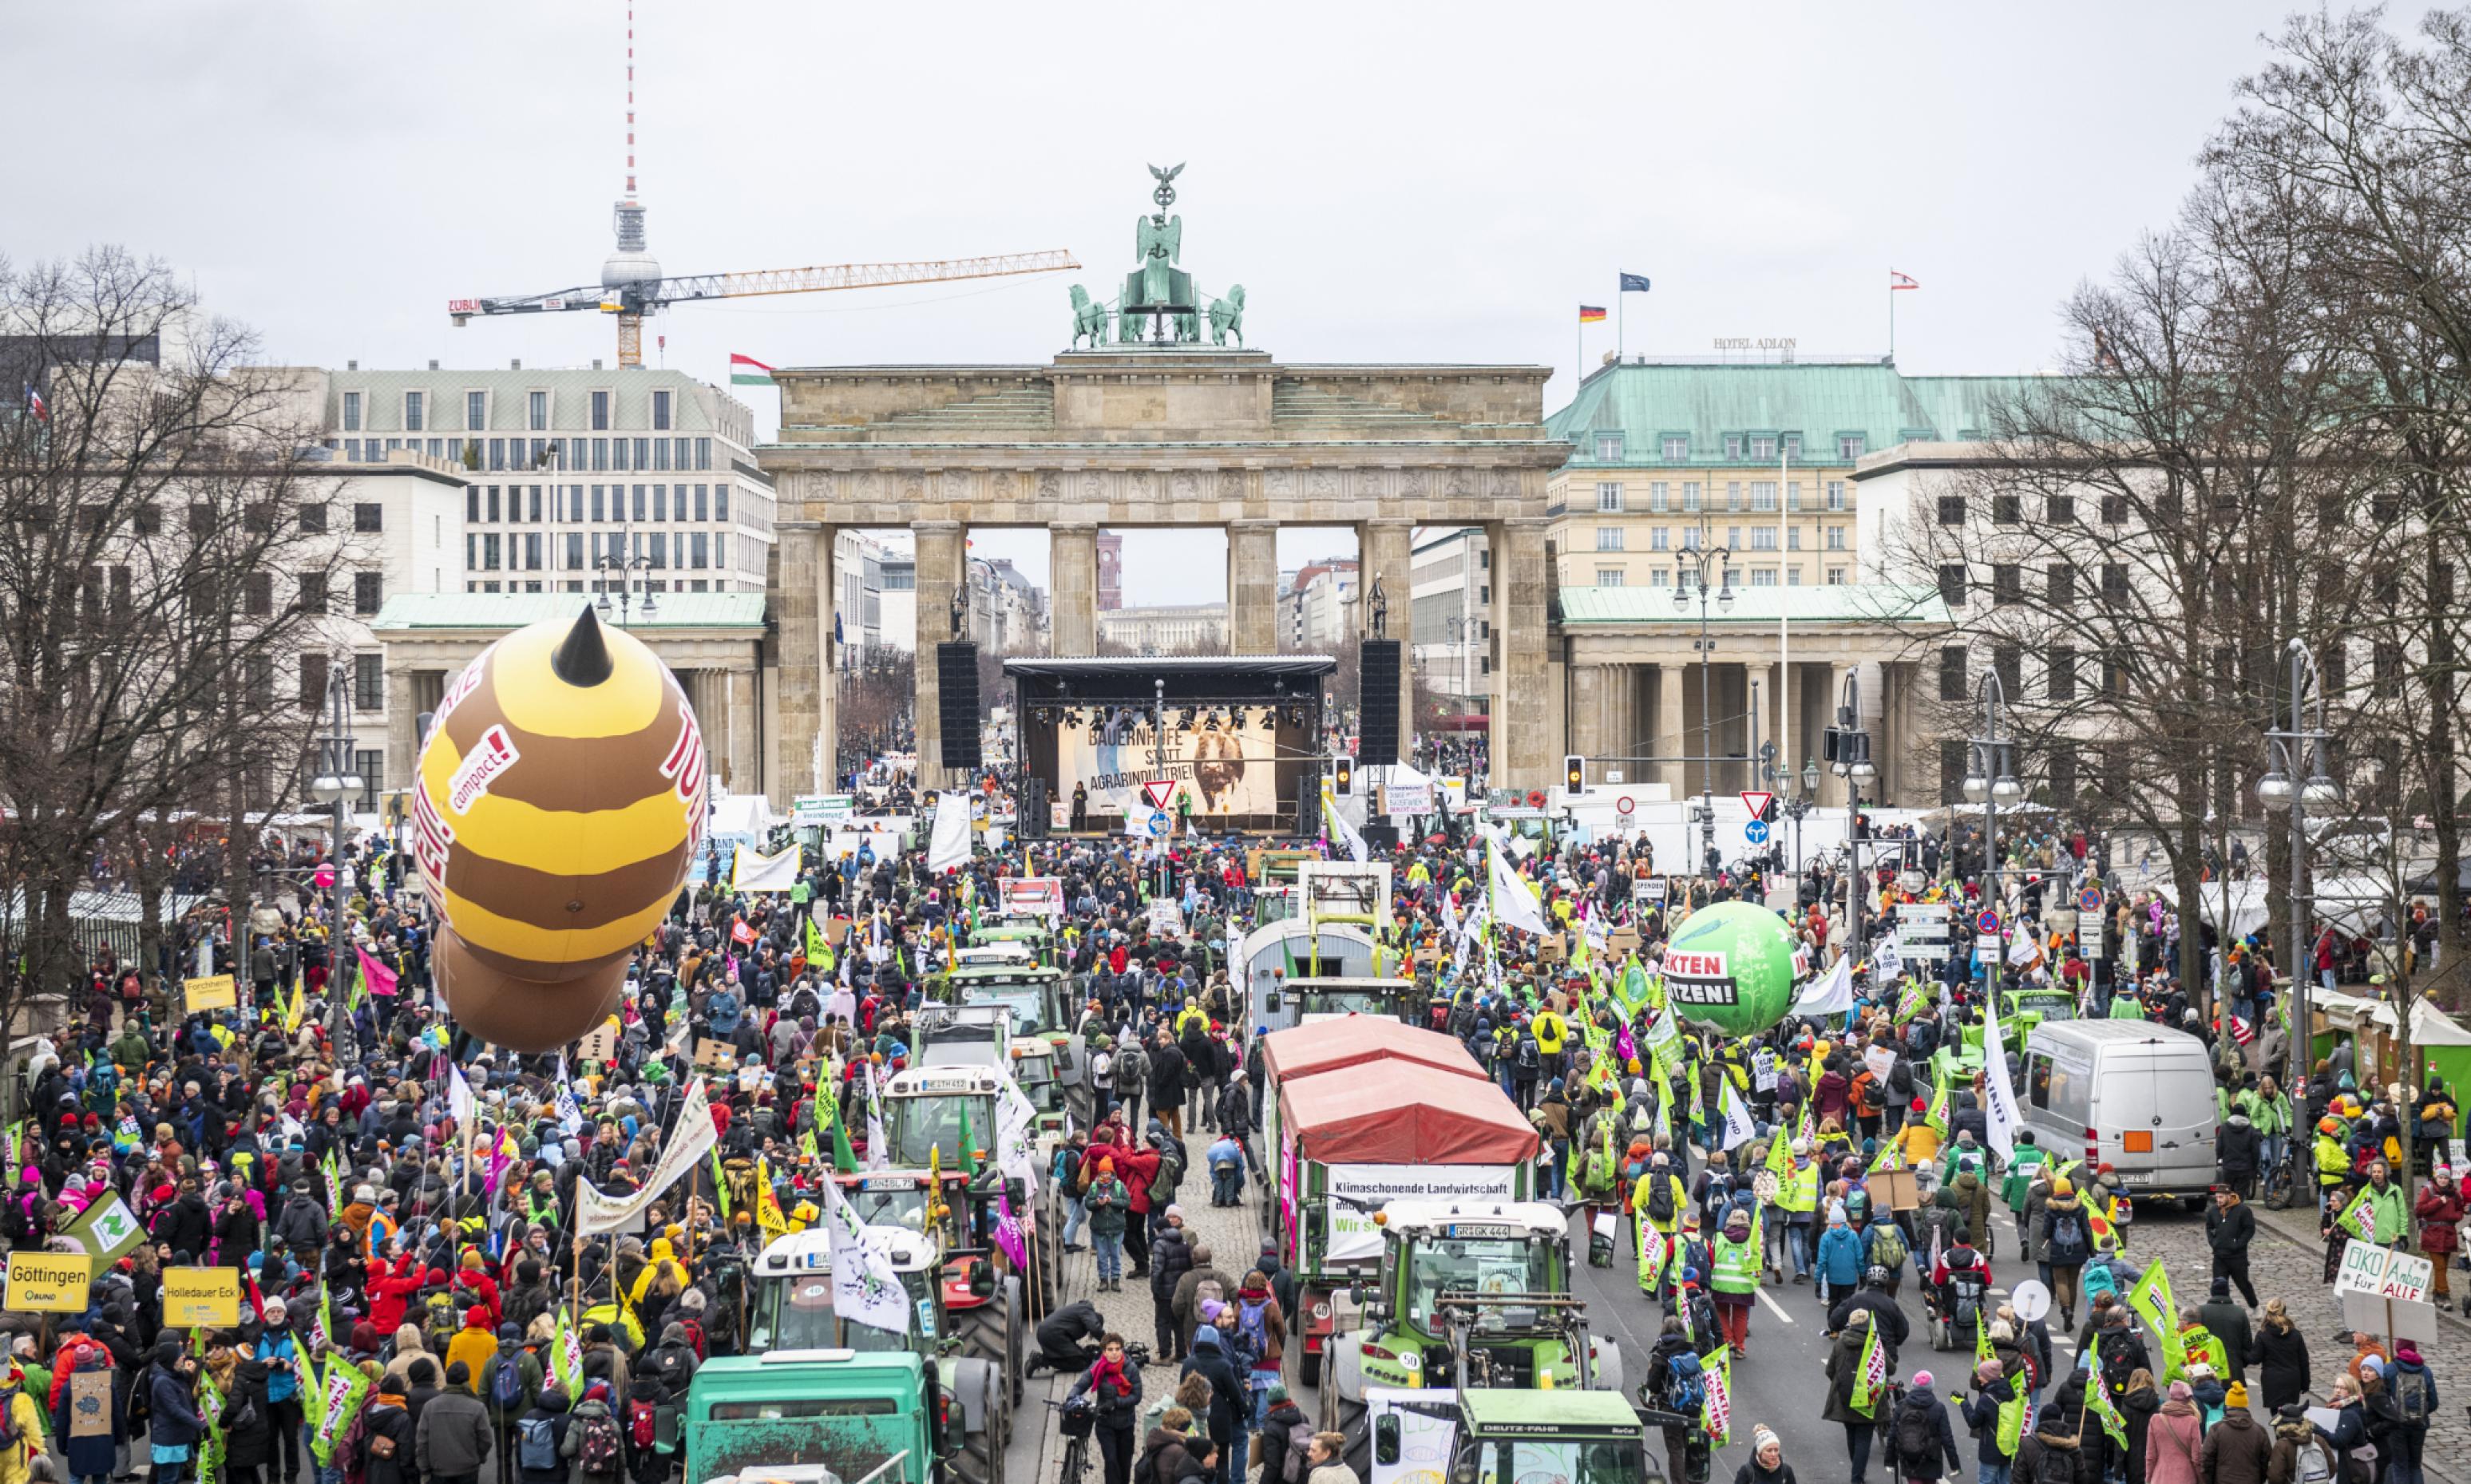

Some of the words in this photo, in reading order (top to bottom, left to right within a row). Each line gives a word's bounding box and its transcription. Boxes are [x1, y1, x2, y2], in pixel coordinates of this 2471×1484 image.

[1713, 338, 1752, 349] HOTEL
[1756, 338, 1797, 349] ADLON
[1090, 765, 1192, 791] AGRARINDUTRIE!
[187, 979, 232, 990] Forchheim
[1336, 1182, 1424, 1194] Klimaschonende
[1428, 1183, 1507, 1194] Landwirtschaft
[1336, 1218, 1359, 1233] Wir
[1456, 1226, 1468, 1237] GR
[1475, 1226, 1487, 1237] GK
[1490, 1226, 1507, 1237] 444
[12, 1265, 86, 1287] Göttingen
[2386, 1261, 2425, 1288] Anbau
[2354, 1274, 2375, 1290] für
[167, 1287, 217, 1298] Holledauer
[220, 1287, 236, 1298] Eck
[1316, 1304, 1328, 1316] 40
[1404, 1355, 1417, 1367] 50
